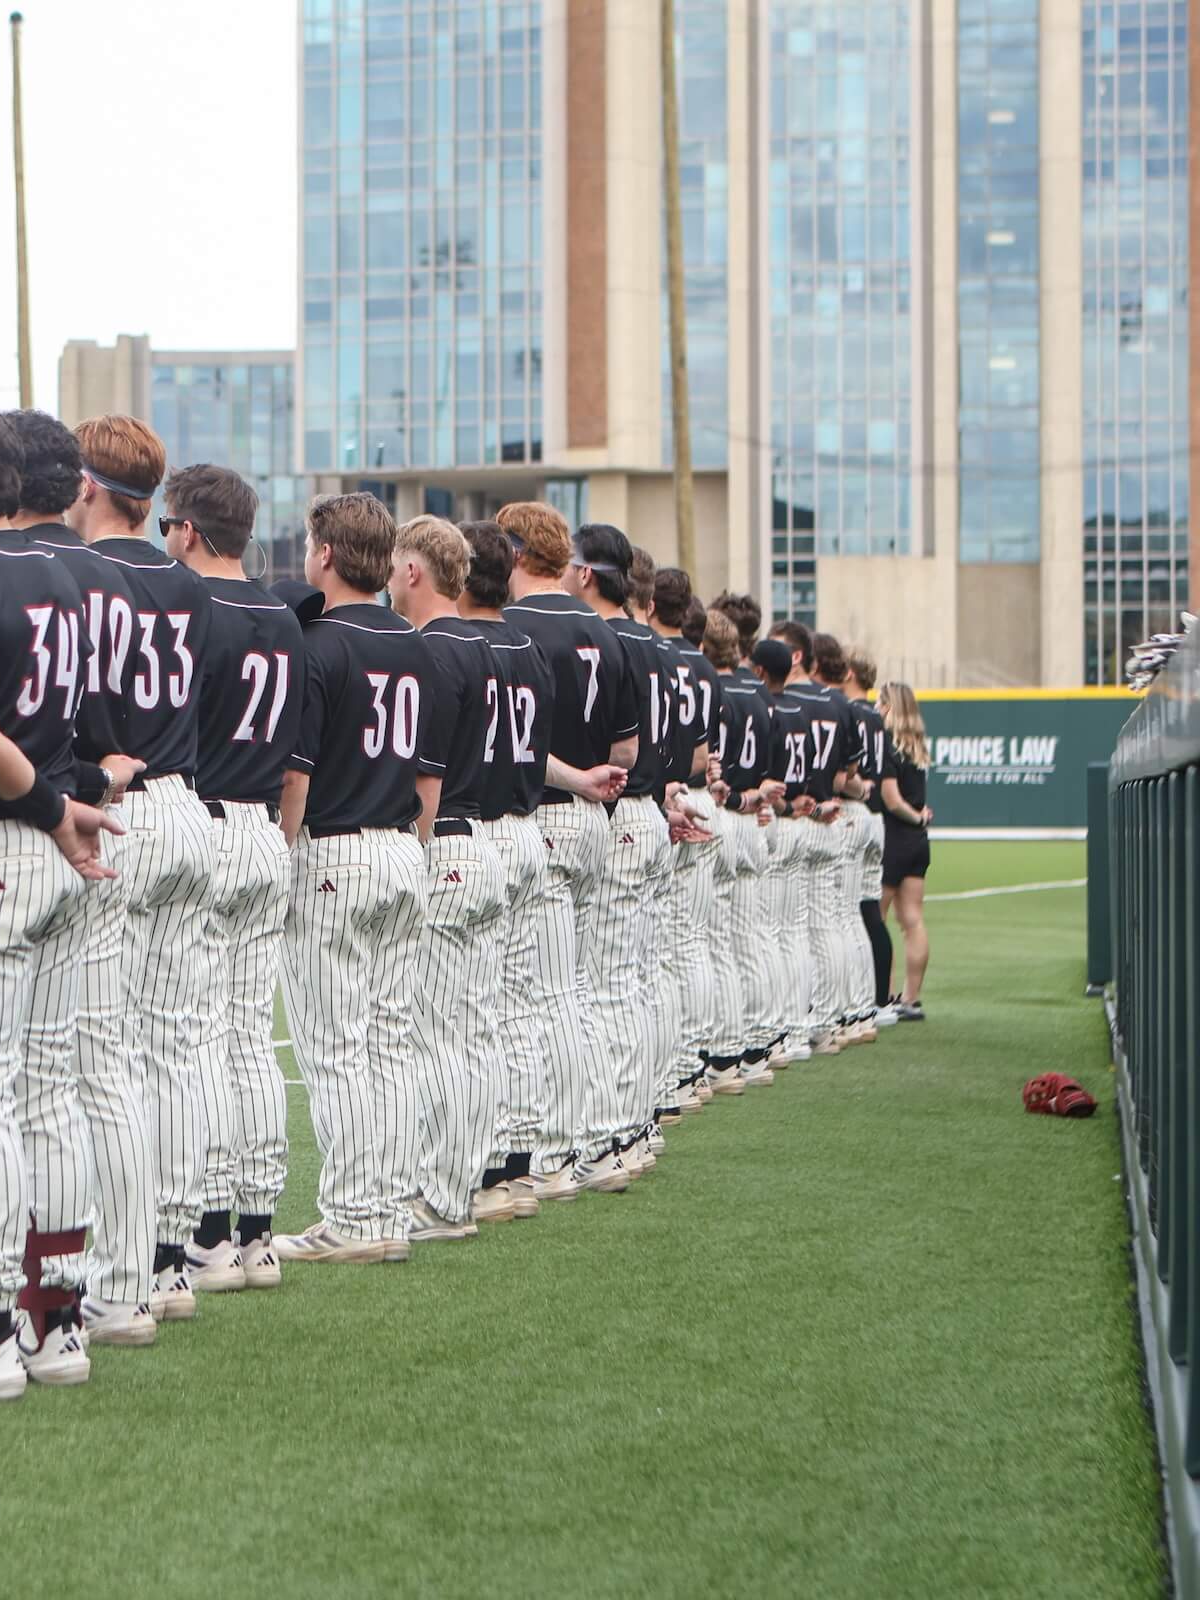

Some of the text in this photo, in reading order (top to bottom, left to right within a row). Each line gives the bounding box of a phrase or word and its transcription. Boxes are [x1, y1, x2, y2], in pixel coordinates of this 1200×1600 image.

[15, 602, 80, 721] 34
[133, 609, 195, 711] 33
[230, 650, 291, 745] 21
[575, 645, 601, 724] 7
[361, 670, 422, 761] 30
[810, 719, 838, 771] 17
[935, 736, 1005, 767] PONCE
[1009, 736, 1058, 767] LAW
[783, 731, 806, 784] 23
[944, 772, 1046, 785] JUSTICE FOR ALL
